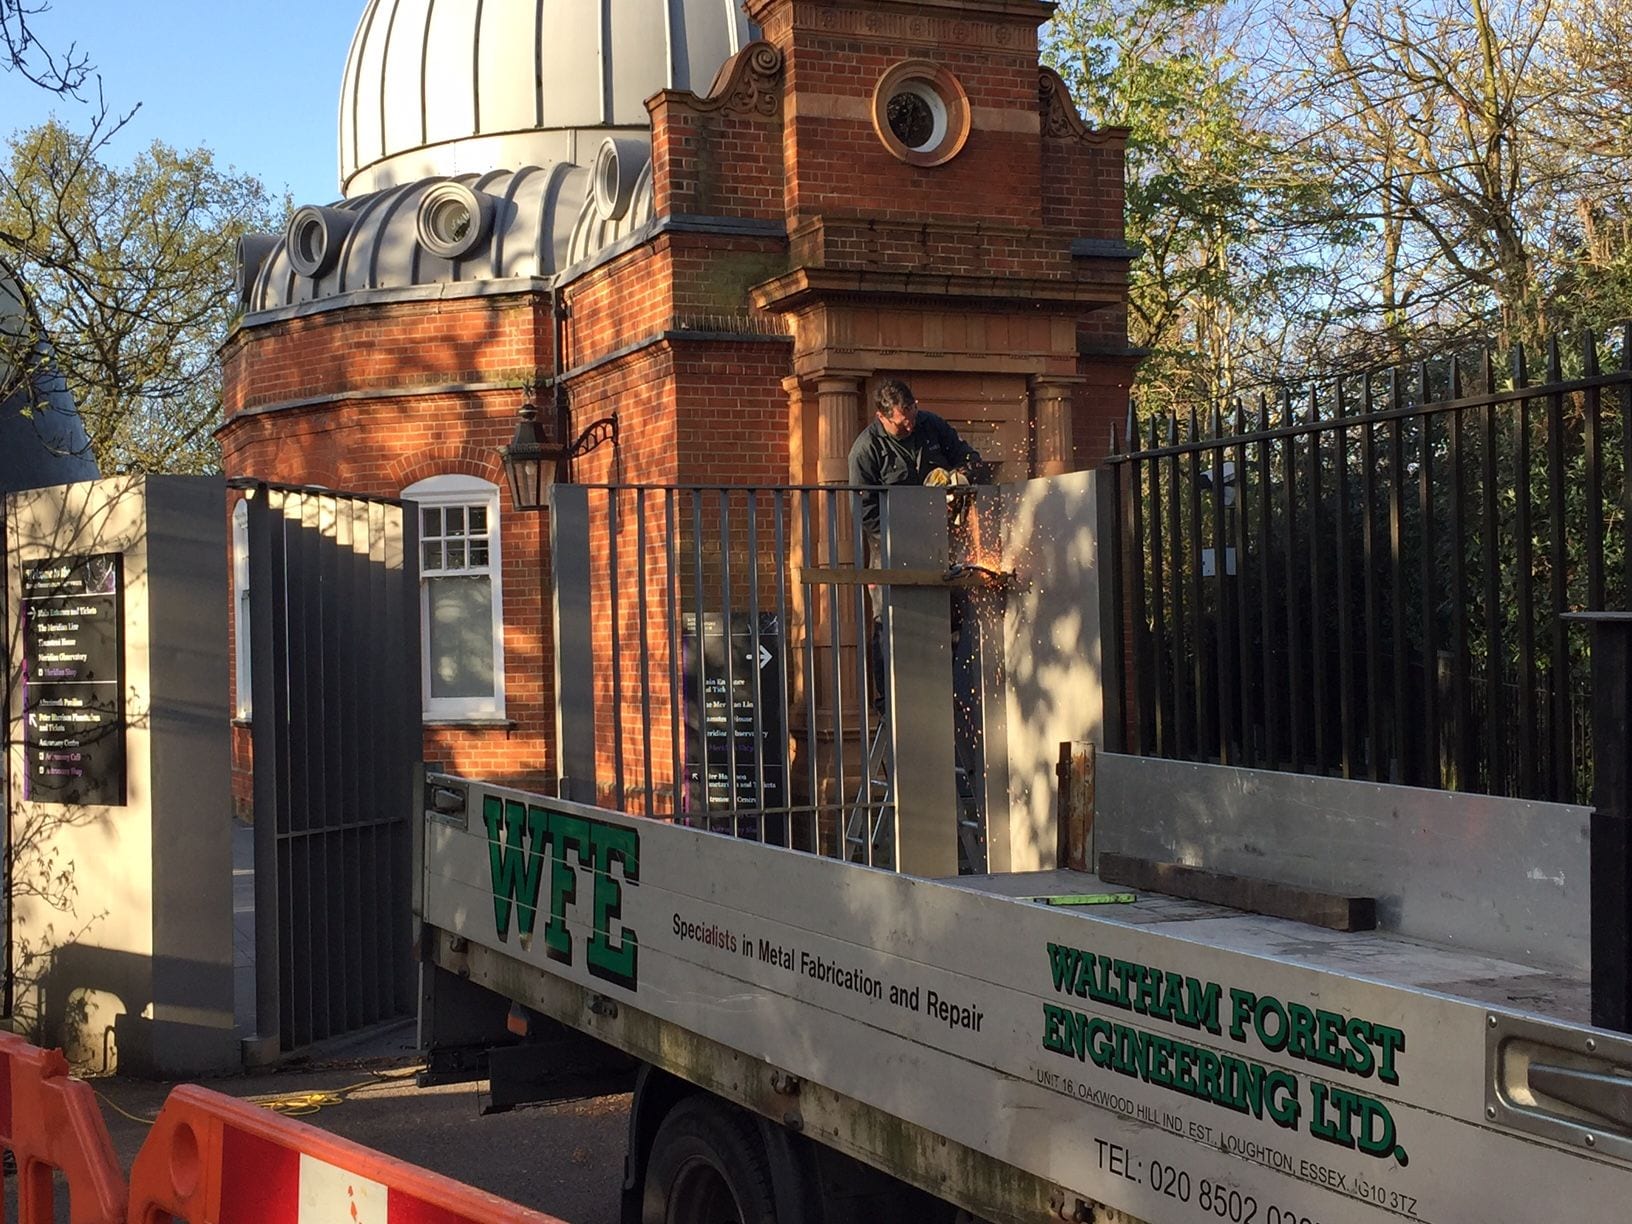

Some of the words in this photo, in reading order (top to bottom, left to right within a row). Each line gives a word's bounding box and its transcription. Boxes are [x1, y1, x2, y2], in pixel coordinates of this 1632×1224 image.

[37, 623, 47, 632] The
[482, 793, 641, 993] WFE
[673, 913, 738, 953] Specialists
[743, 932, 754, 957] in
[759, 938, 797, 973] Metal
[801, 952, 882, 1000] Fabrication
[890, 981, 920, 1013] and
[928, 990, 985, 1033] Repair
[1046, 941, 1223, 1036] WALTHAM
[1229, 987, 1406, 1087] FOREST
[1036, 1068, 1060, 1087] UNIT
[1078, 1083, 1134, 1115] OAKWOOD
[1136, 1104, 1161, 1126] HILL
[1390, 1191, 1418, 1216] 3TZ
[1042, 1002, 1302, 1132] ENGINEERING
[1309, 1080, 1408, 1167] LTD.
[1094, 1137, 1142, 1184] TEL:
[1150, 1160, 1192, 1203] 020
[1199, 1178, 1258, 1224] 8502
